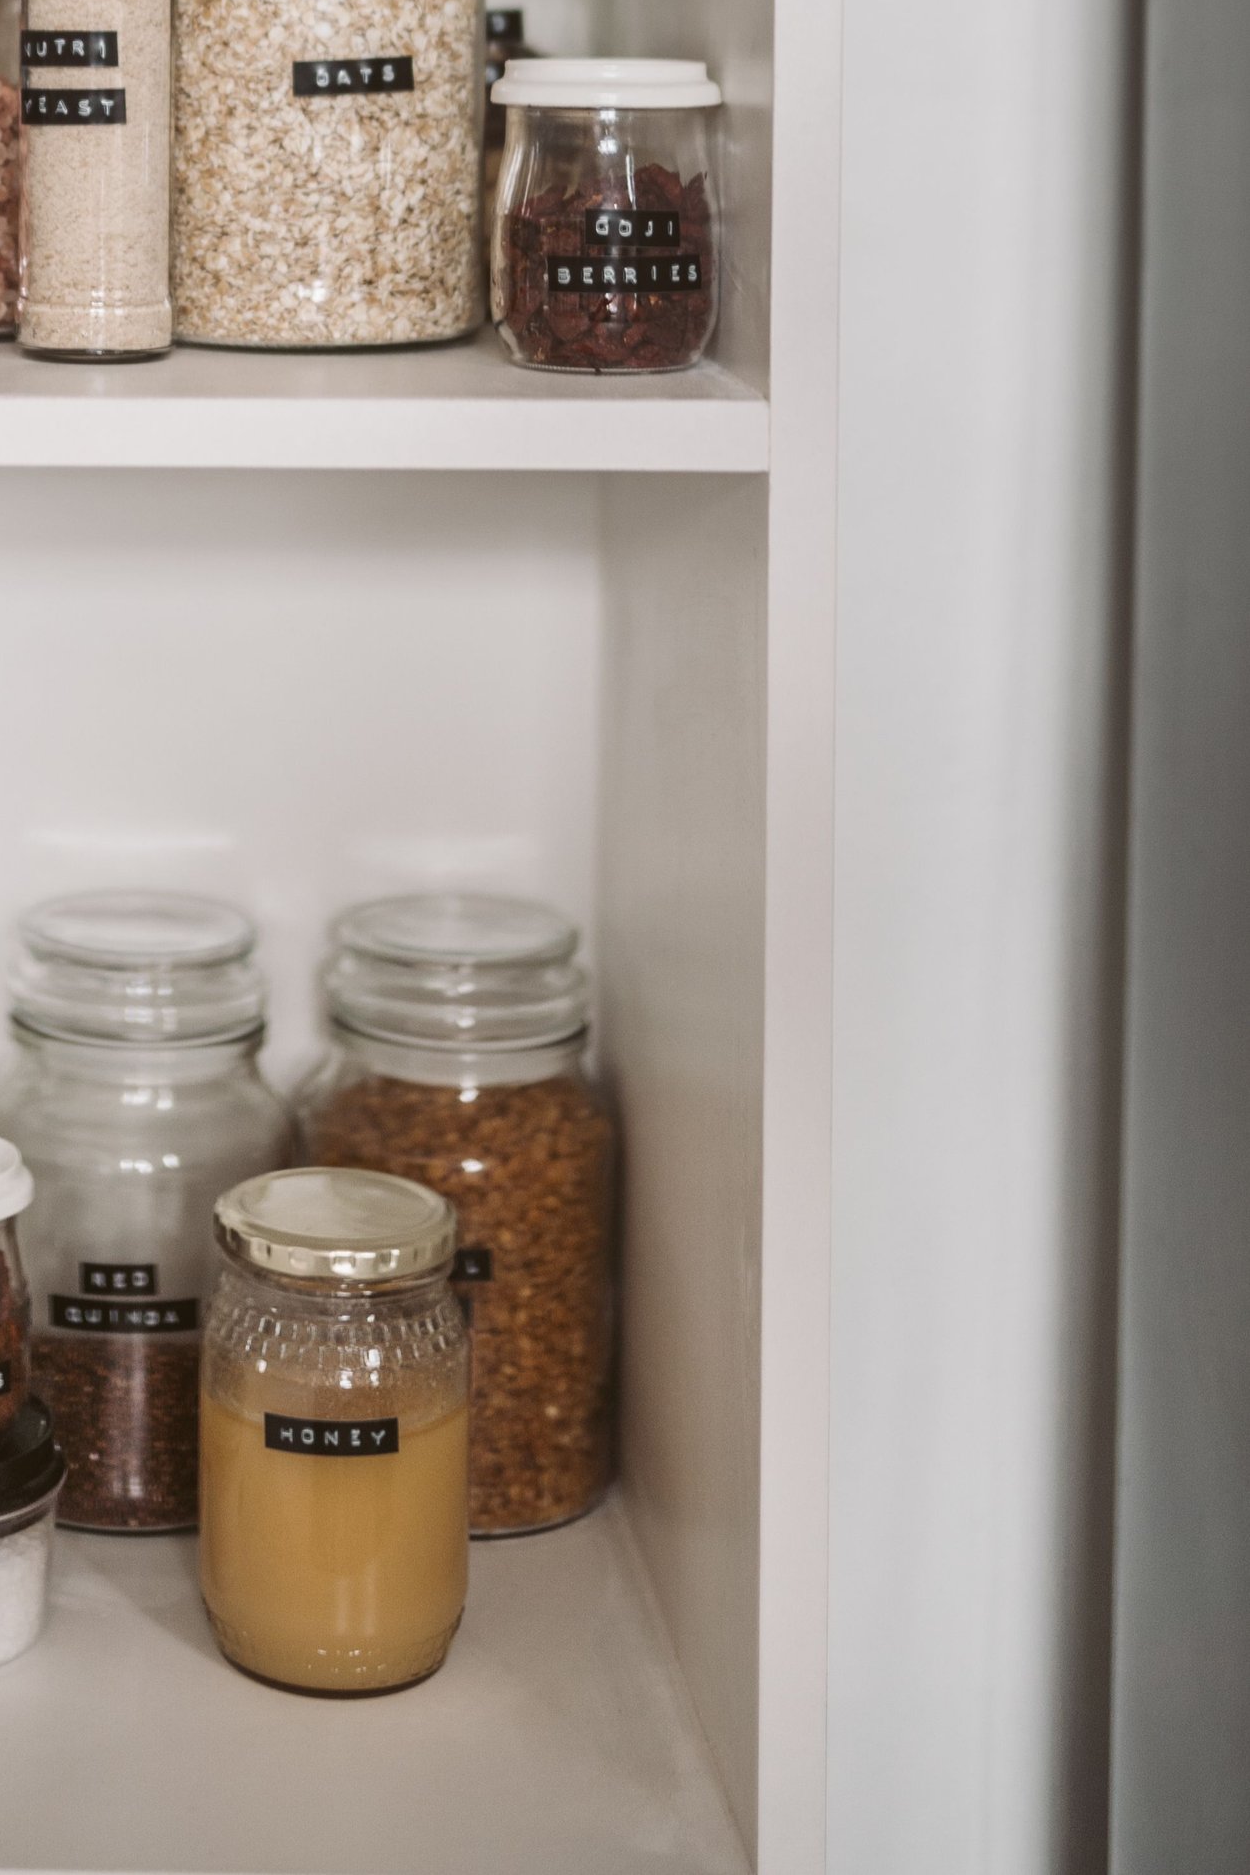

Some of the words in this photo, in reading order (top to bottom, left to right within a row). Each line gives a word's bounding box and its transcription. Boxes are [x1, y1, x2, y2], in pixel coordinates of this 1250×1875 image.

[316, 64, 395, 88] OATS
[24, 96, 114, 117] YEAST
[595, 214, 673, 237] GOJI
[558, 265, 698, 285] BERRIES
[280, 1427, 386, 1447] HONEY
